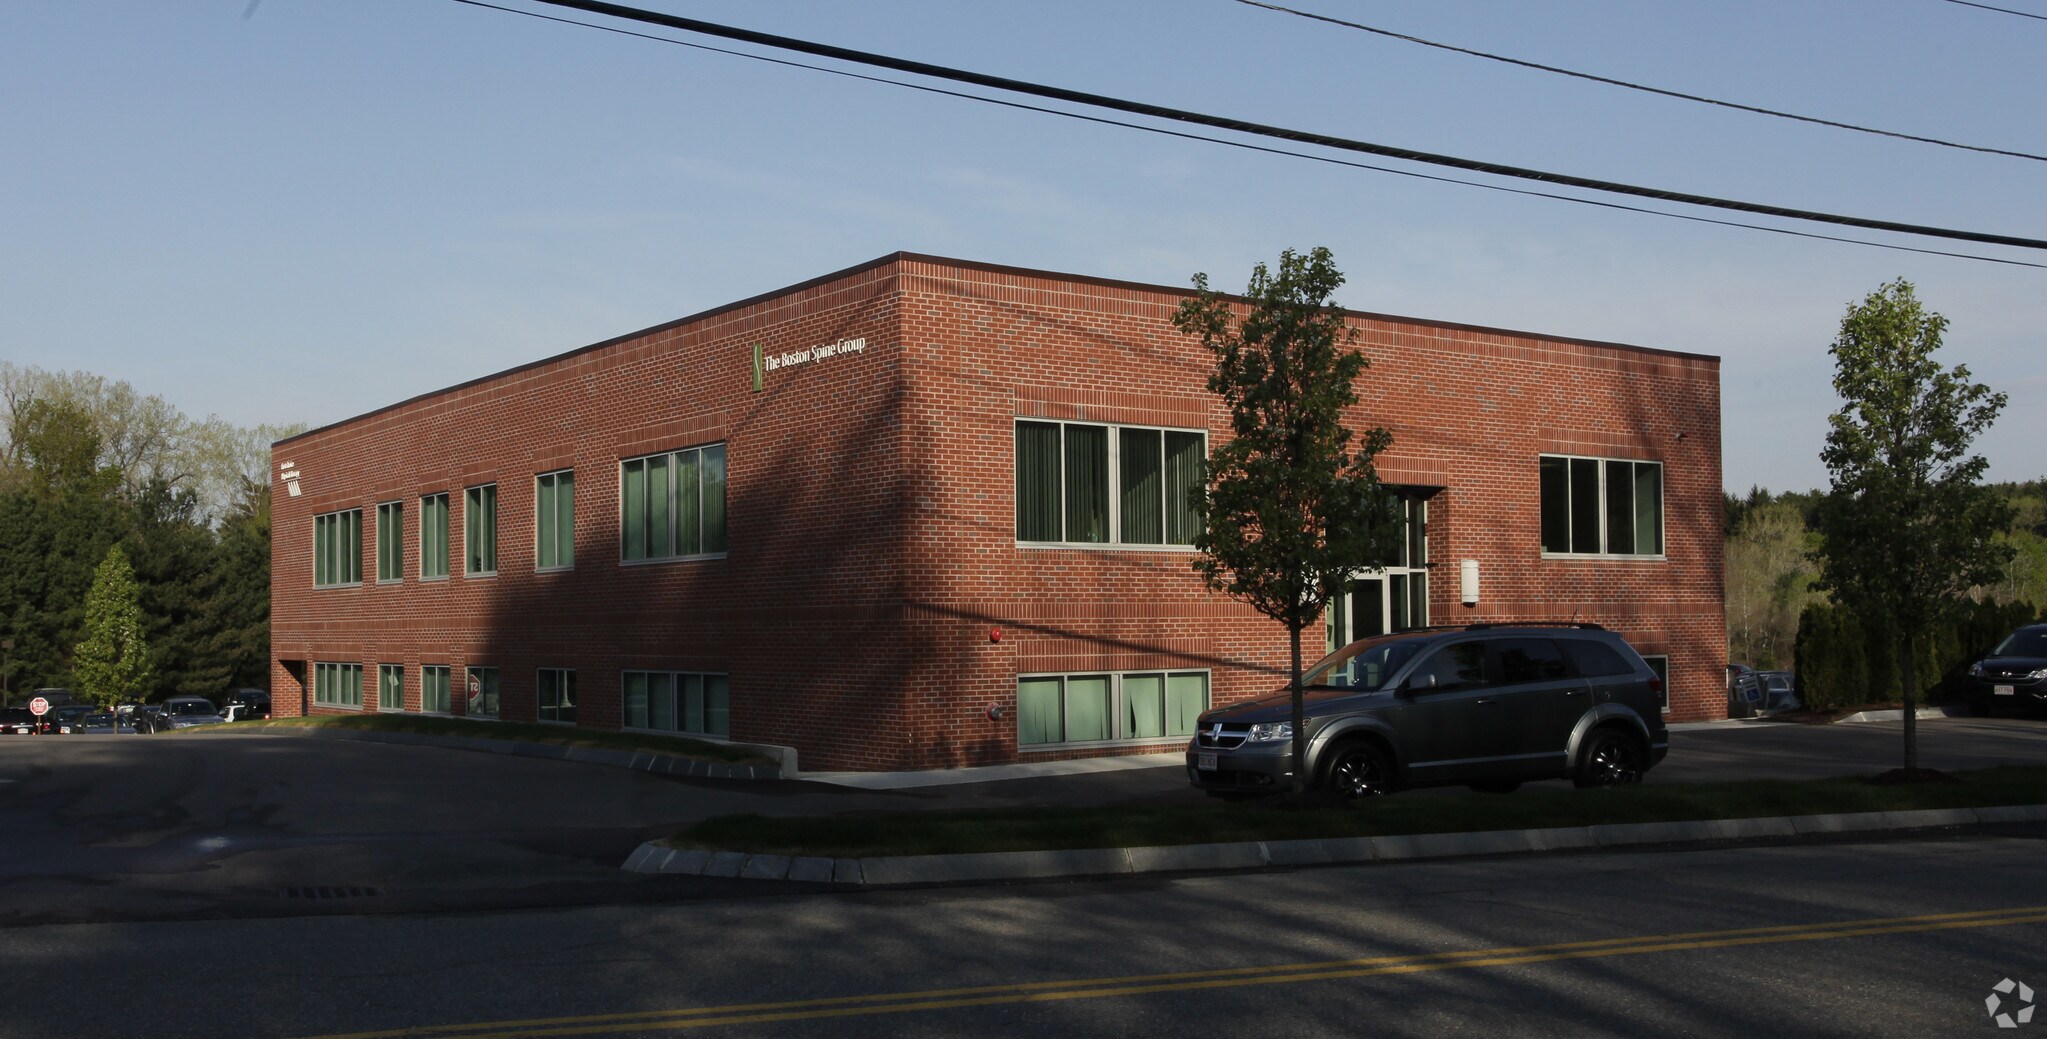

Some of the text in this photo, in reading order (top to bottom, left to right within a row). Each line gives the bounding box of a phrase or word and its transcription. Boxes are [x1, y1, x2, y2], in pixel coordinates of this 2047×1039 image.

[764, 337, 866, 371] The Boston Spine Group
